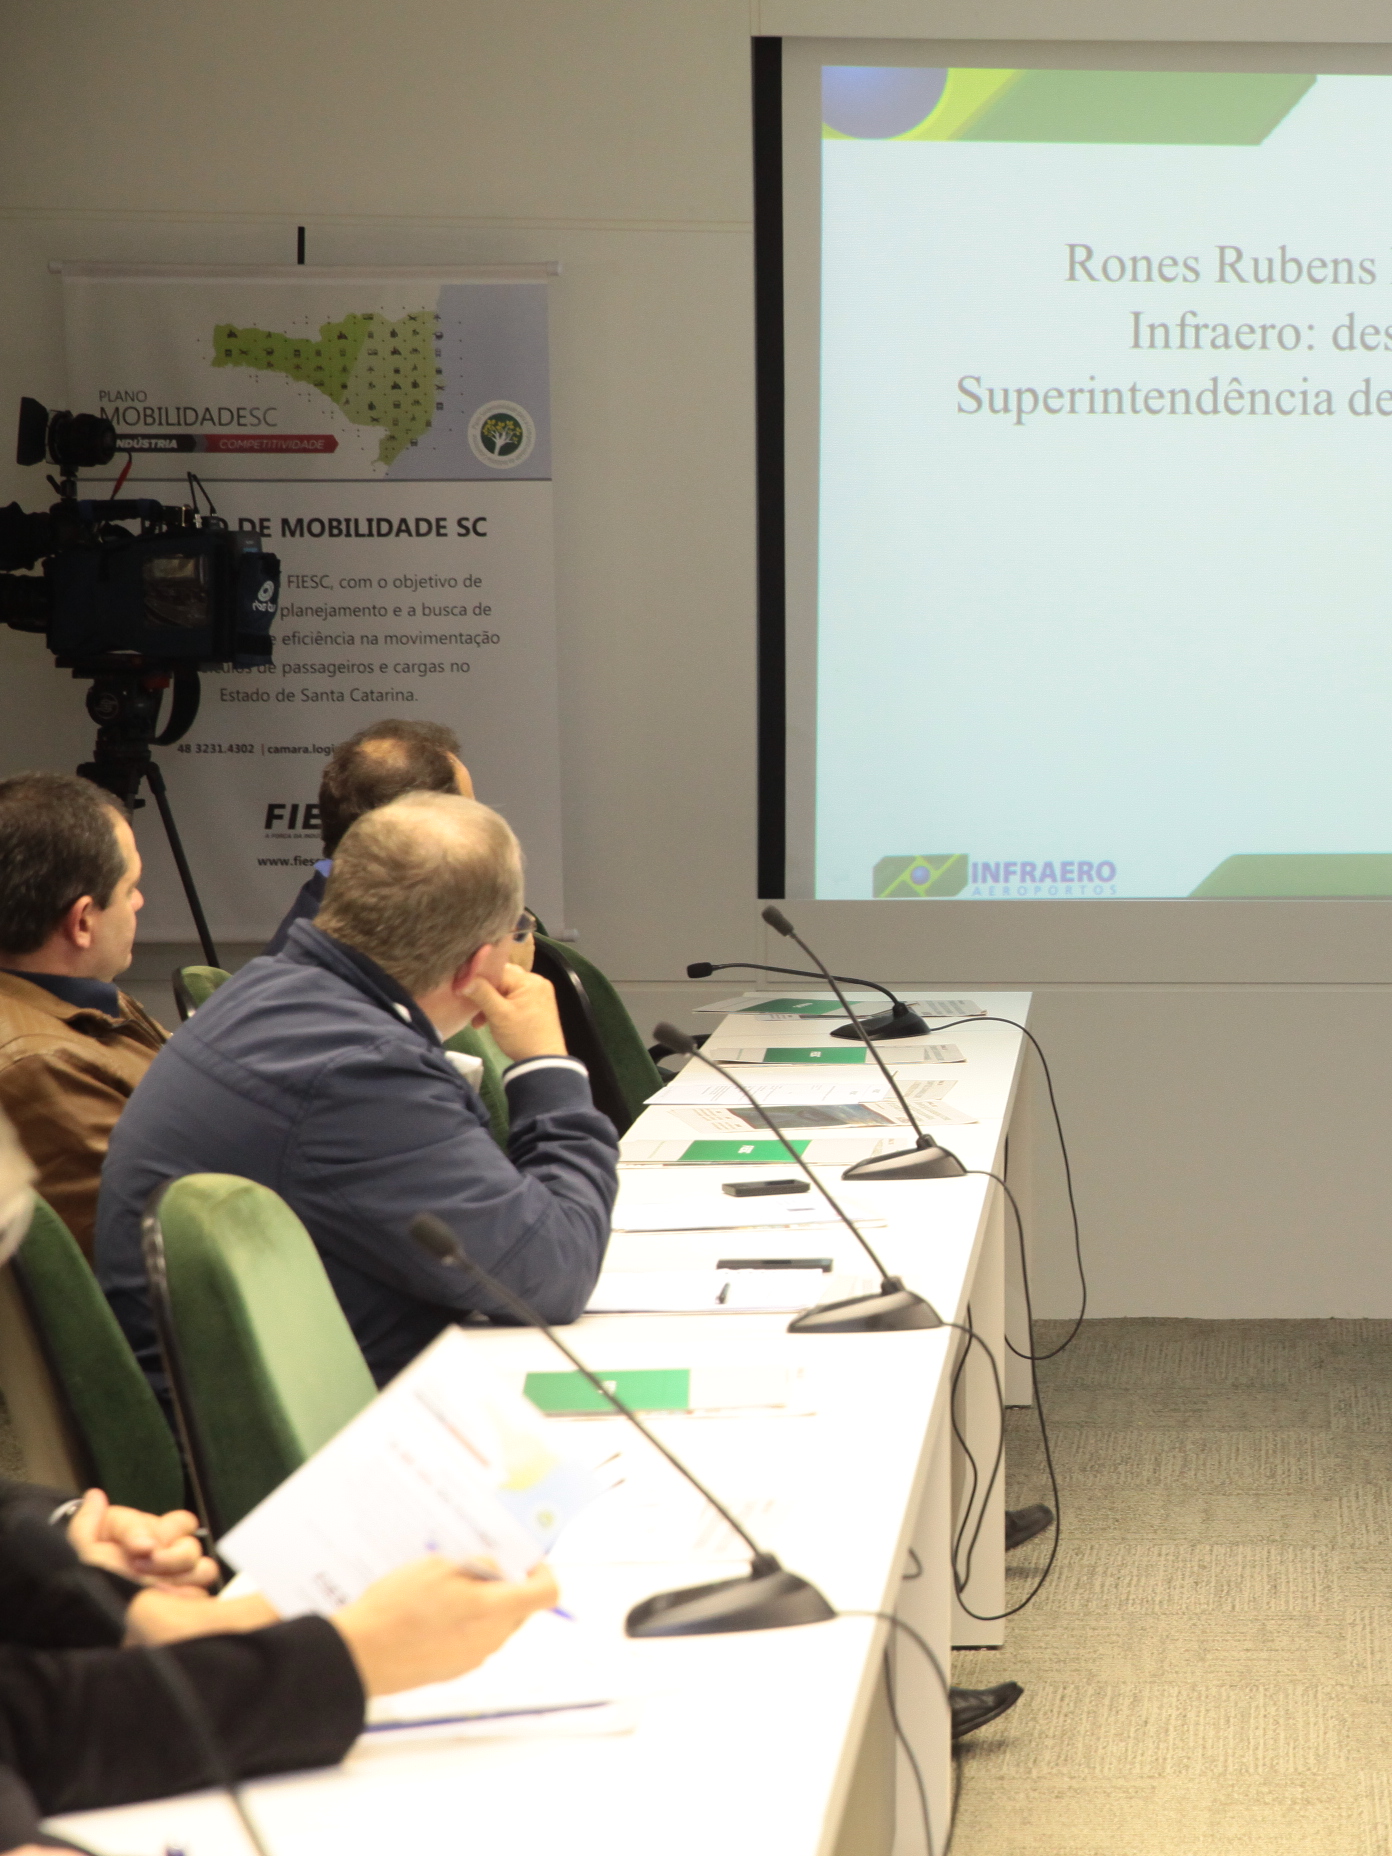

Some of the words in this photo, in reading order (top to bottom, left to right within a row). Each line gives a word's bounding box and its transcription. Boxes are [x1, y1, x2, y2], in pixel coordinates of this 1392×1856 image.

[1065, 243, 1201, 283] Rones
[1216, 244, 1377, 285] Rubens
[1130, 310, 1315, 351] Infraero:
[98, 390, 147, 402] PLANO
[957, 375, 1336, 426] Superintendência
[100, 406, 278, 427] MOBILIDADESC
[116, 437, 178, 449] NDÚSTRIA
[219, 438, 326, 450] COMPETITIVIDADE
[238, 518, 271, 537] DE
[281, 516, 449, 538] MOBILIDADE
[456, 517, 488, 537] SC
[286, 574, 334, 591] FIESC,
[339, 578, 372, 589] com
[378, 578, 388, 589] o
[393, 573, 459, 593] objetivo
[463, 574, 483, 589] de
[279, 602, 388, 621] planejamento
[393, 606, 402, 618] e
[407, 606, 417, 617] a
[422, 602, 468, 617] busca
[472, 602, 492, 617] de
[282, 630, 355, 646] eficiência
[360, 634, 379, 646] na
[384, 631, 500, 649] movimentação
[282, 660, 375, 678] passageiros
[379, 664, 389, 674] e
[393, 664, 446, 678] cargas
[450, 663, 471, 674] no
[219, 687, 271, 702] Estado
[275, 687, 295, 702] de
[300, 688, 345, 702] Santa
[350, 687, 419, 702] Catarina.
[177, 743, 192, 754] 48
[195, 743, 255, 754] 3231.4302
[267, 743, 334, 757] camara.logi
[264, 803, 323, 830] FIE
[257, 855, 316, 867] www.fies
[970, 860, 1118, 884] INFRAERO
[971, 884, 1118, 897] AEROPORTOS
